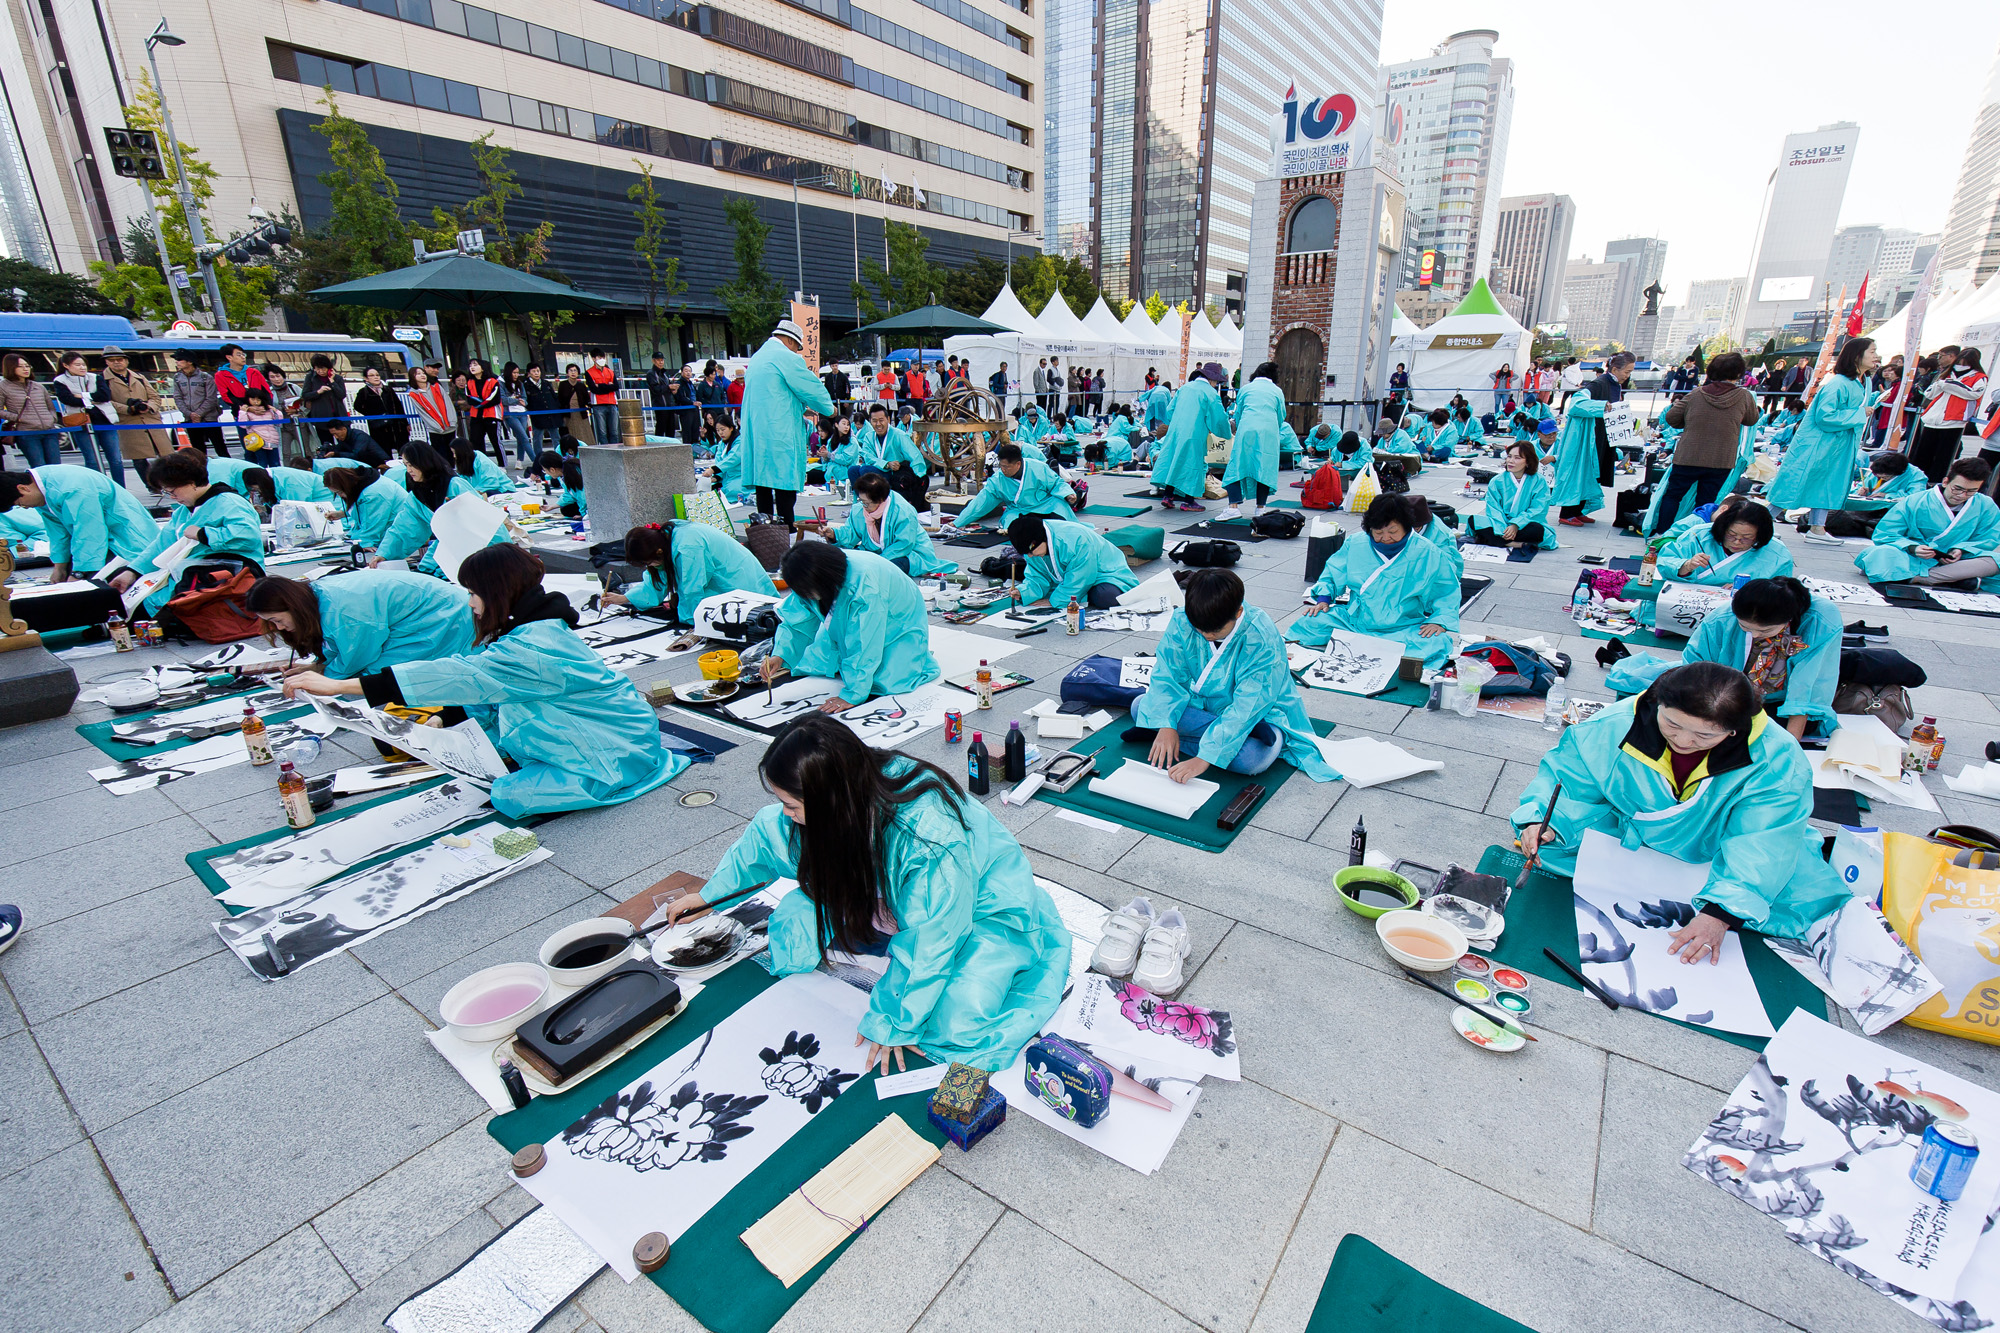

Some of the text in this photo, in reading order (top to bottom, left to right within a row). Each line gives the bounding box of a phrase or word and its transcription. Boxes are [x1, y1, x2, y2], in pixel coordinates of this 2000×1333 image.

[1283, 142, 1349, 160] 국민이 지킨 역사
[1789, 144, 1846, 160] 조선일보
[1283, 162, 1308, 174] 국민이
[1329, 156, 1348, 168] 나라
[1789, 157, 1842, 167] chosun.com
[1445, 337, 1484, 347] 종합안내소
[1932, 871, 1967, 894] I'M
[1061, 1070, 1083, 1086] To infinity
